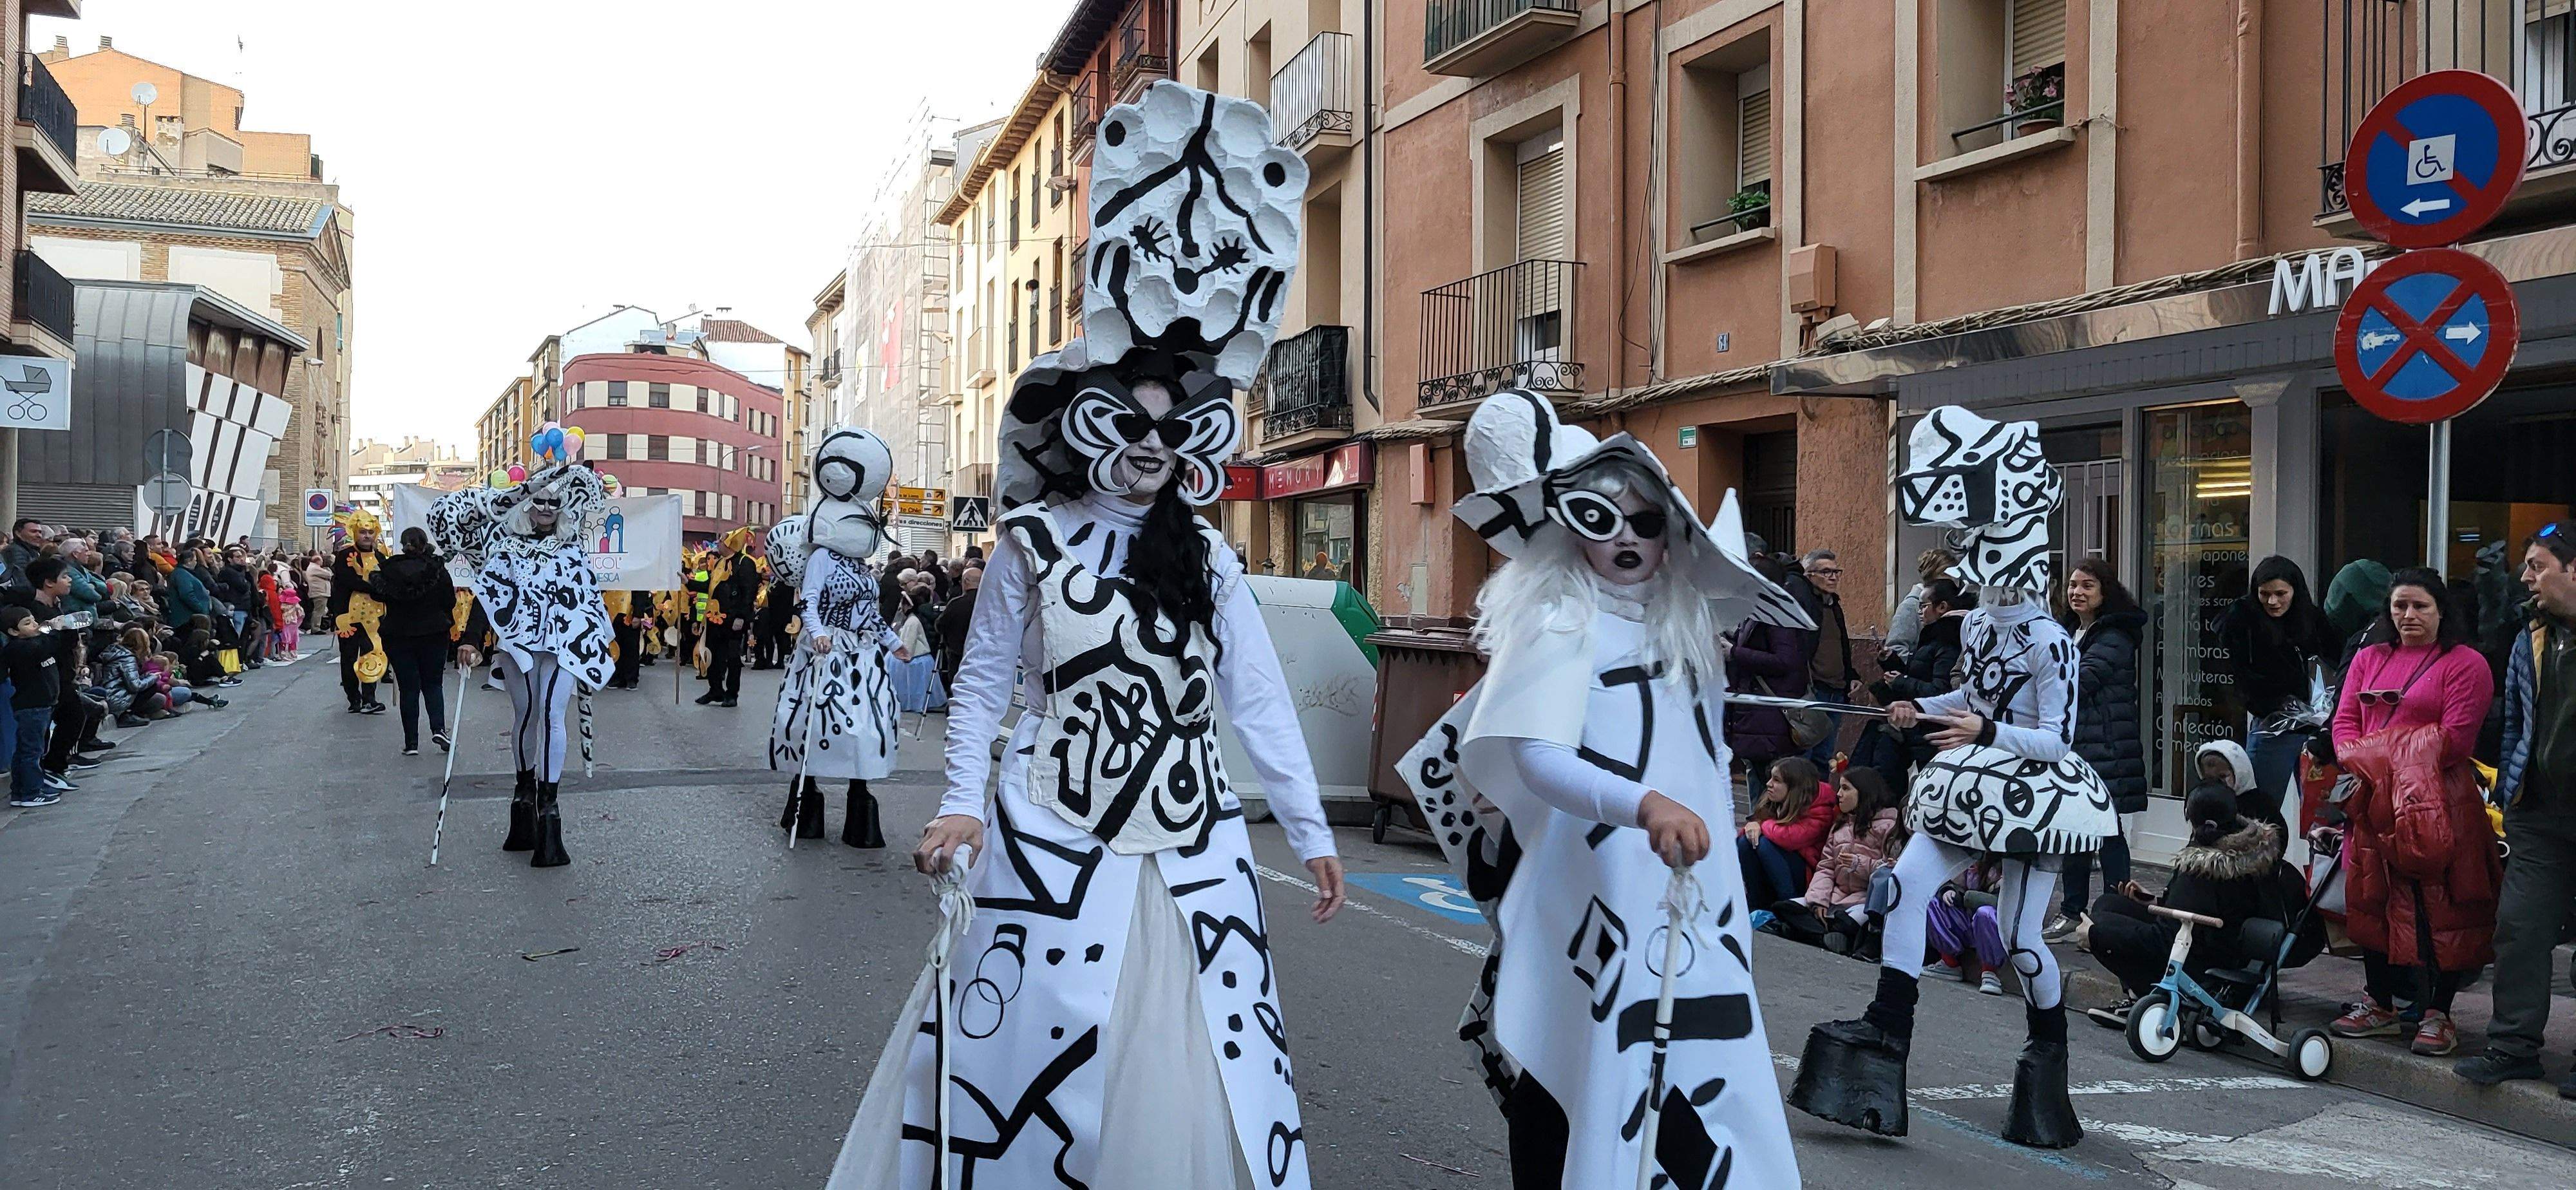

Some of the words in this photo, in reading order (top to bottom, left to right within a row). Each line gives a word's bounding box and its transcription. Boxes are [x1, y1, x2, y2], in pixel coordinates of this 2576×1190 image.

[2268, 247, 2378, 316] MA
[1718, 334, 1727, 351] 64
[908, 519, 943, 527] direcciones
[2157, 641, 2230, 659] Ambras
[2156, 666, 2235, 685] Muiteras
[2155, 716, 2233, 738] Cnfección
